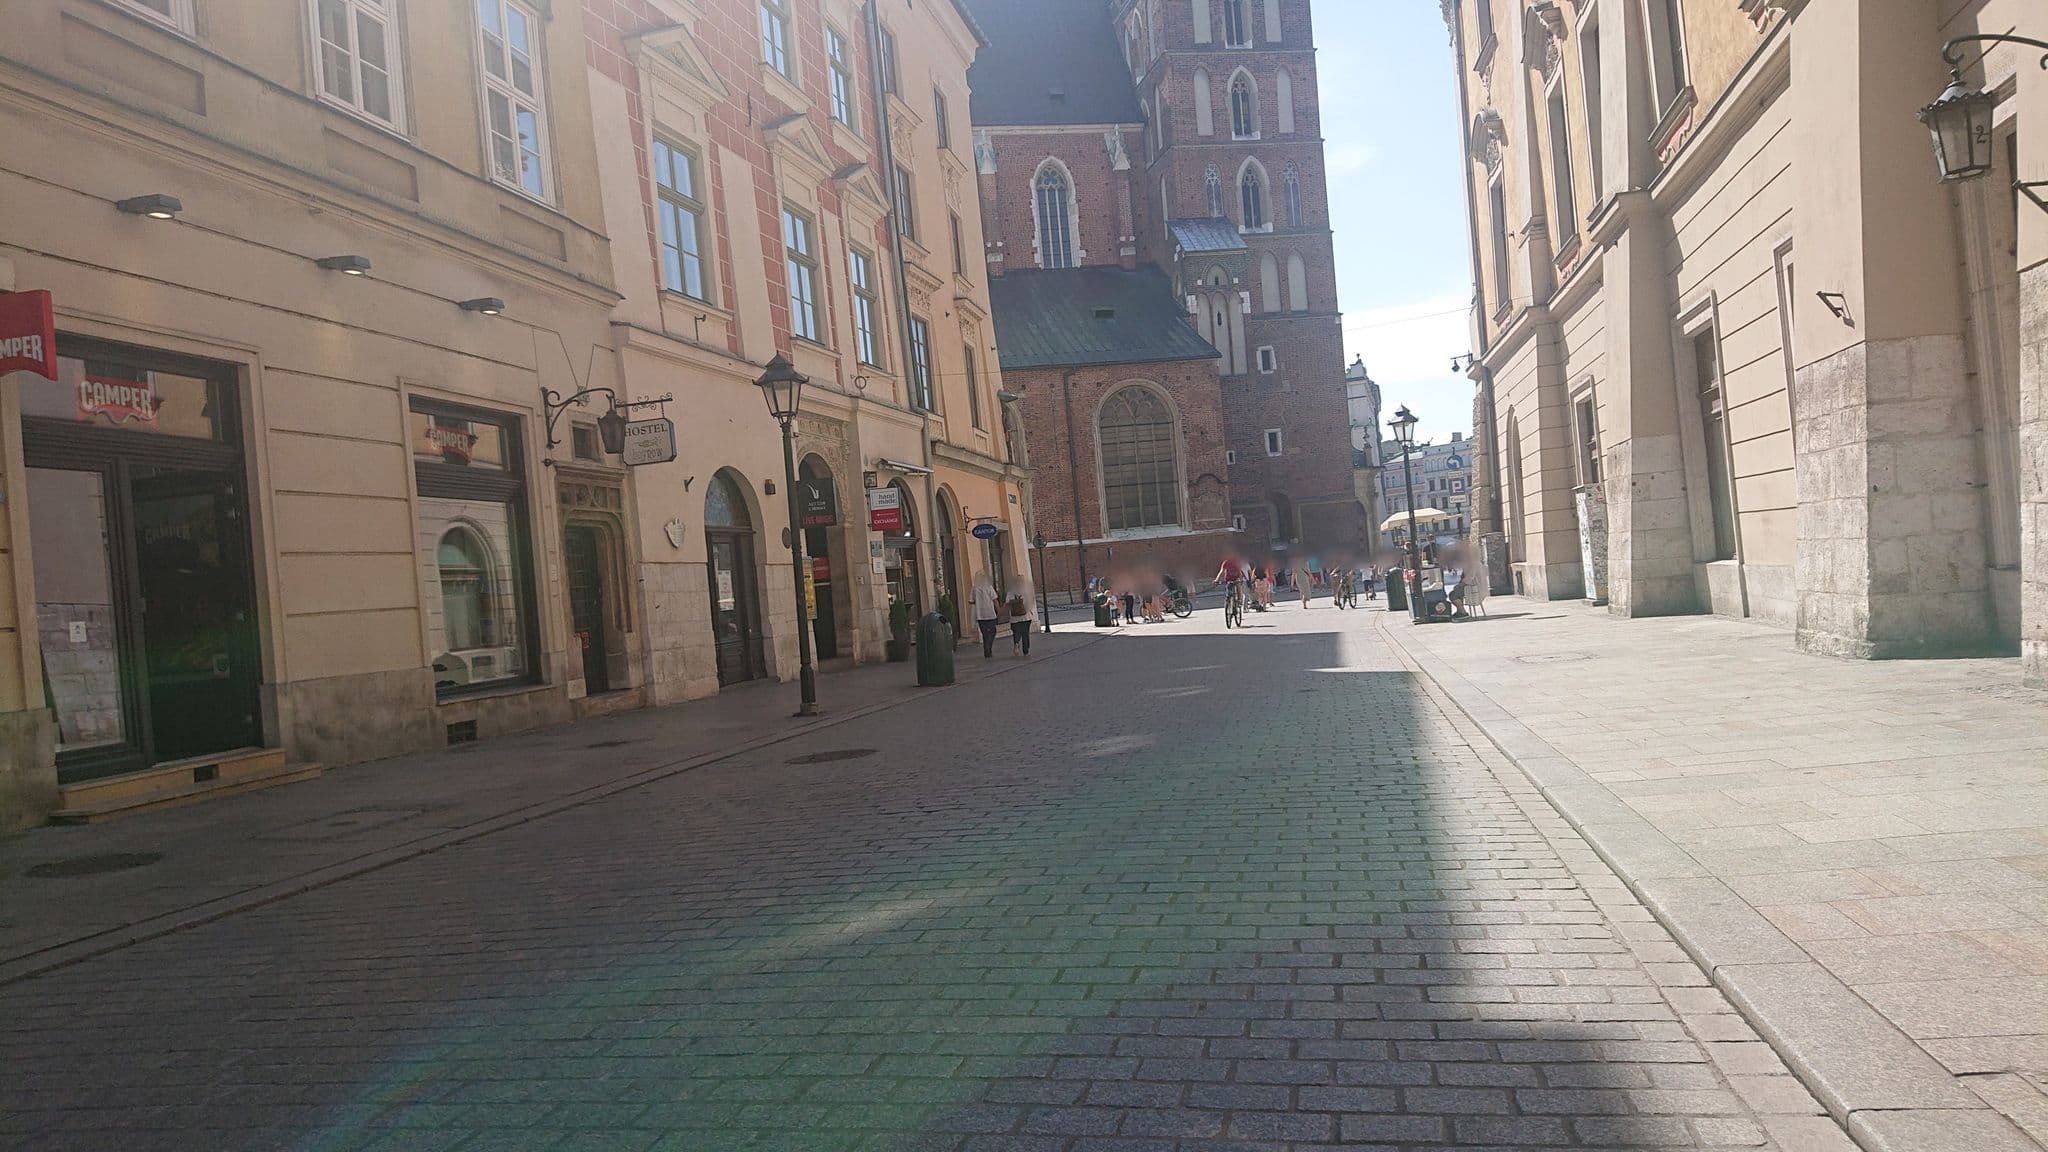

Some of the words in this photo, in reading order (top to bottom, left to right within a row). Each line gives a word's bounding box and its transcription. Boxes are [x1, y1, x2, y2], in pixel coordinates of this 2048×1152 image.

[80, 380, 153, 418] CAMPER
[430, 429, 469, 453] CAMPER
[624, 423, 668, 437] HOSTEL
